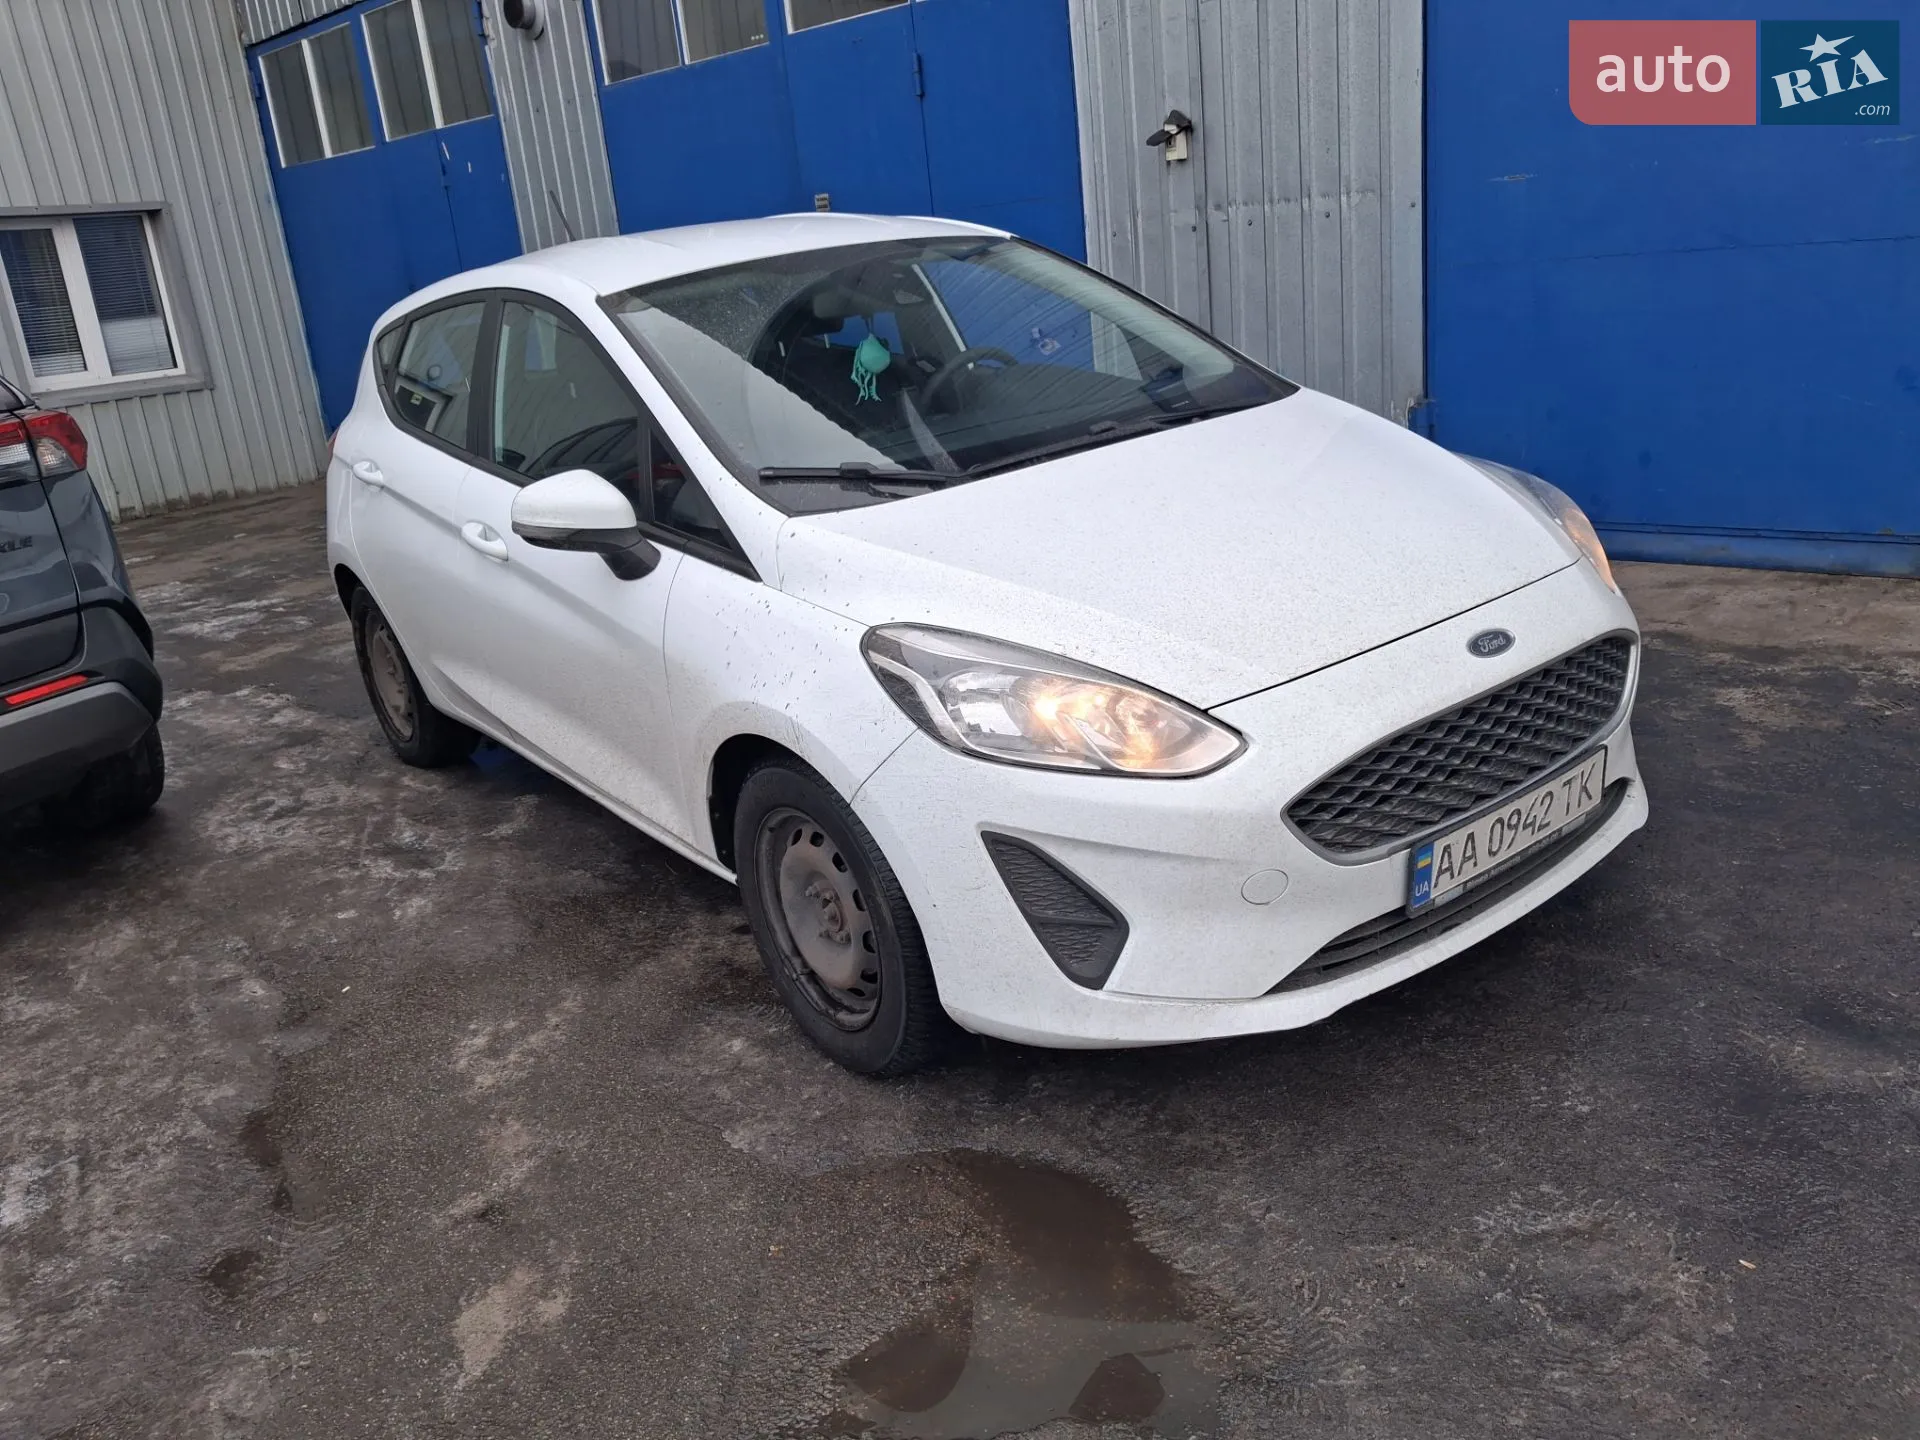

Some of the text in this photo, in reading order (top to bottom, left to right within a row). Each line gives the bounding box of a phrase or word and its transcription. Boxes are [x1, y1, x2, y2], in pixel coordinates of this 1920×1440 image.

[1477, 633, 1506, 653] Ford
[1432, 831, 1478, 889] AA
[1487, 790, 1555, 858] 0942
[1561, 762, 1597, 817] TK
[1415, 881, 1430, 897] UA
